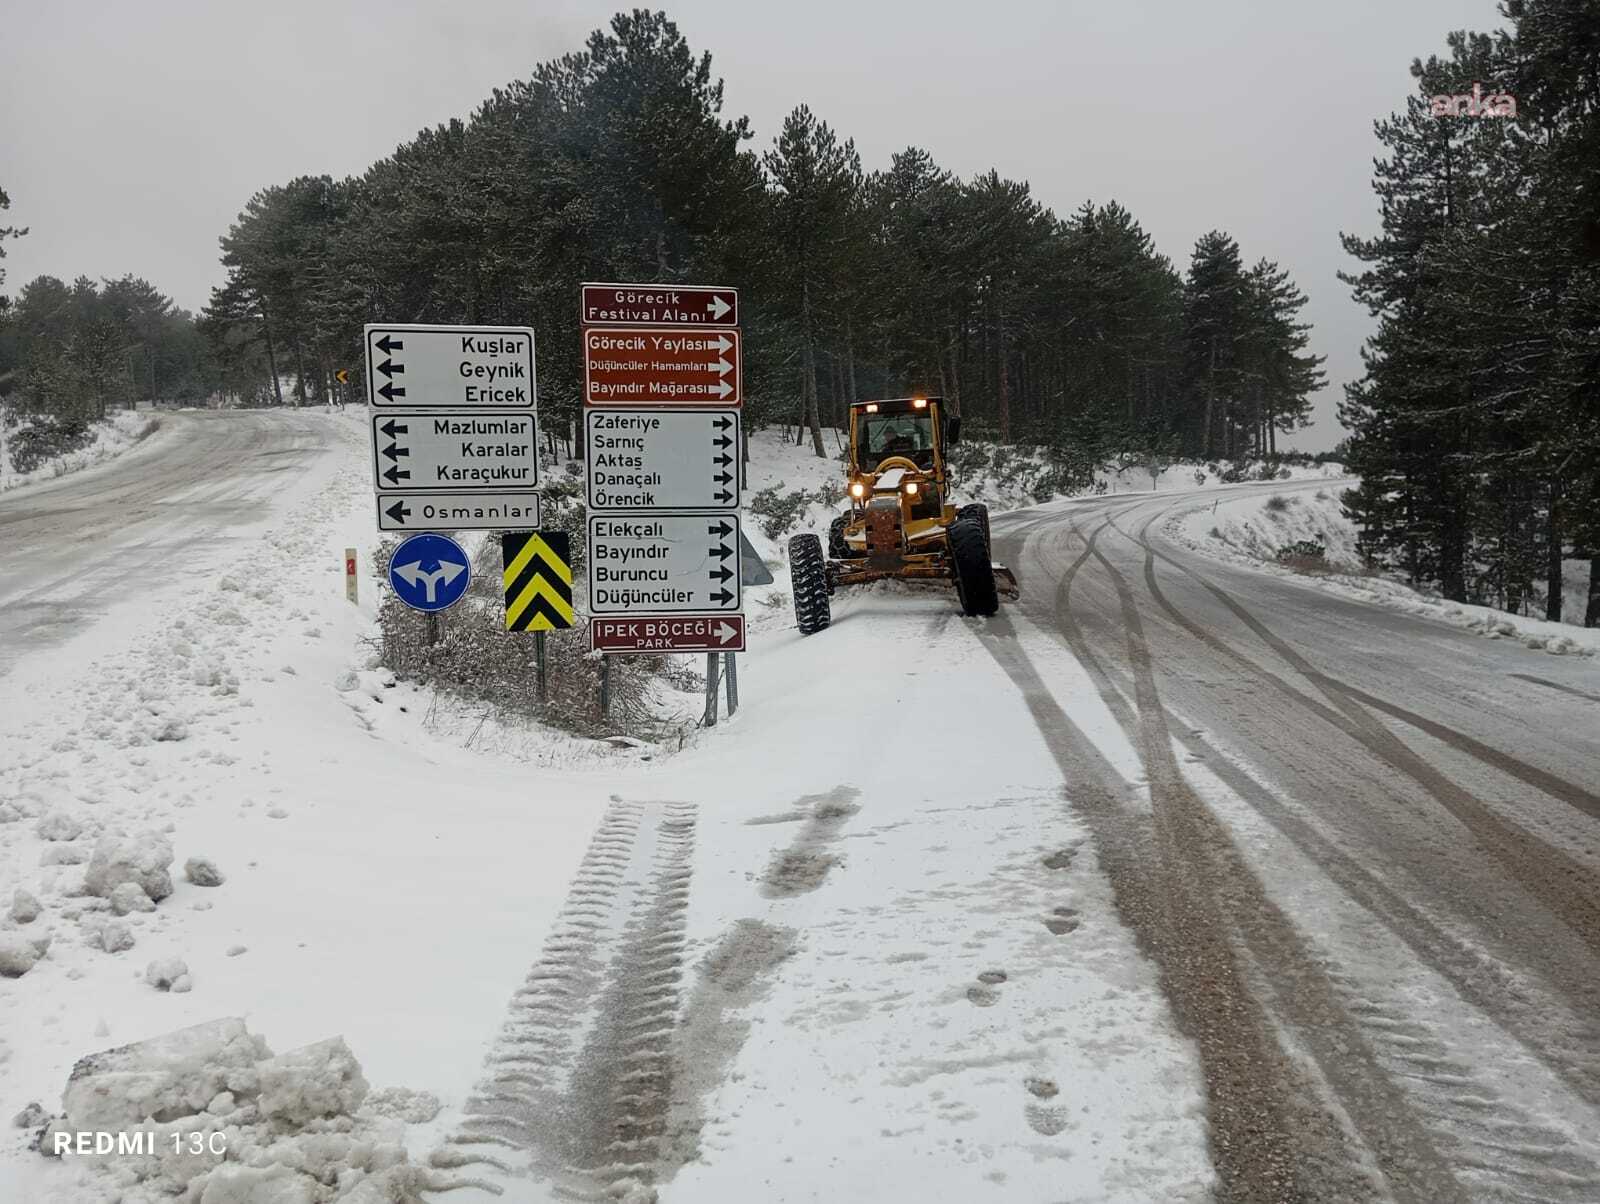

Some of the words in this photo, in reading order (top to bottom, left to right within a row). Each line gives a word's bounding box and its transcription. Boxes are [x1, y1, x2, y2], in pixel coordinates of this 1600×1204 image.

[615, 291, 680, 305] Görecik
[589, 307, 656, 320] Festival
[662, 309, 706, 322] Alanı
[461, 336, 524, 358] Kuşlar
[589, 336, 646, 350] Görecik
[651, 336, 708, 355] Yaylası
[459, 361, 525, 383] Geynik
[590, 360, 648, 373] Düğüncüler
[651, 361, 707, 372] Hamamları
[466, 385, 526, 402] Ericek
[590, 381, 645, 396] Bayındır
[649, 382, 707, 396] Mağarası
[434, 419, 527, 435] Mazlumlar
[594, 415, 660, 433] Zaferiye
[462, 442, 528, 457] Karalar
[594, 435, 644, 452] Sarnıç
[595, 453, 642, 470] Aktaş
[437, 465, 529, 483] Karaçukur
[595, 472, 661, 488] Danaçalı
[595, 489, 655, 506] Örencik
[423, 504, 533, 519] Osmanlar
[595, 522, 663, 540] Elekçalı
[595, 544, 669, 564] Bayındır
[596, 567, 668, 582] Buruncu
[596, 588, 694, 608] Düğüncüler
[597, 622, 639, 637] İPEK
[646, 619, 712, 636] BÖCEĞİ
[637, 638, 673, 648] PARK
